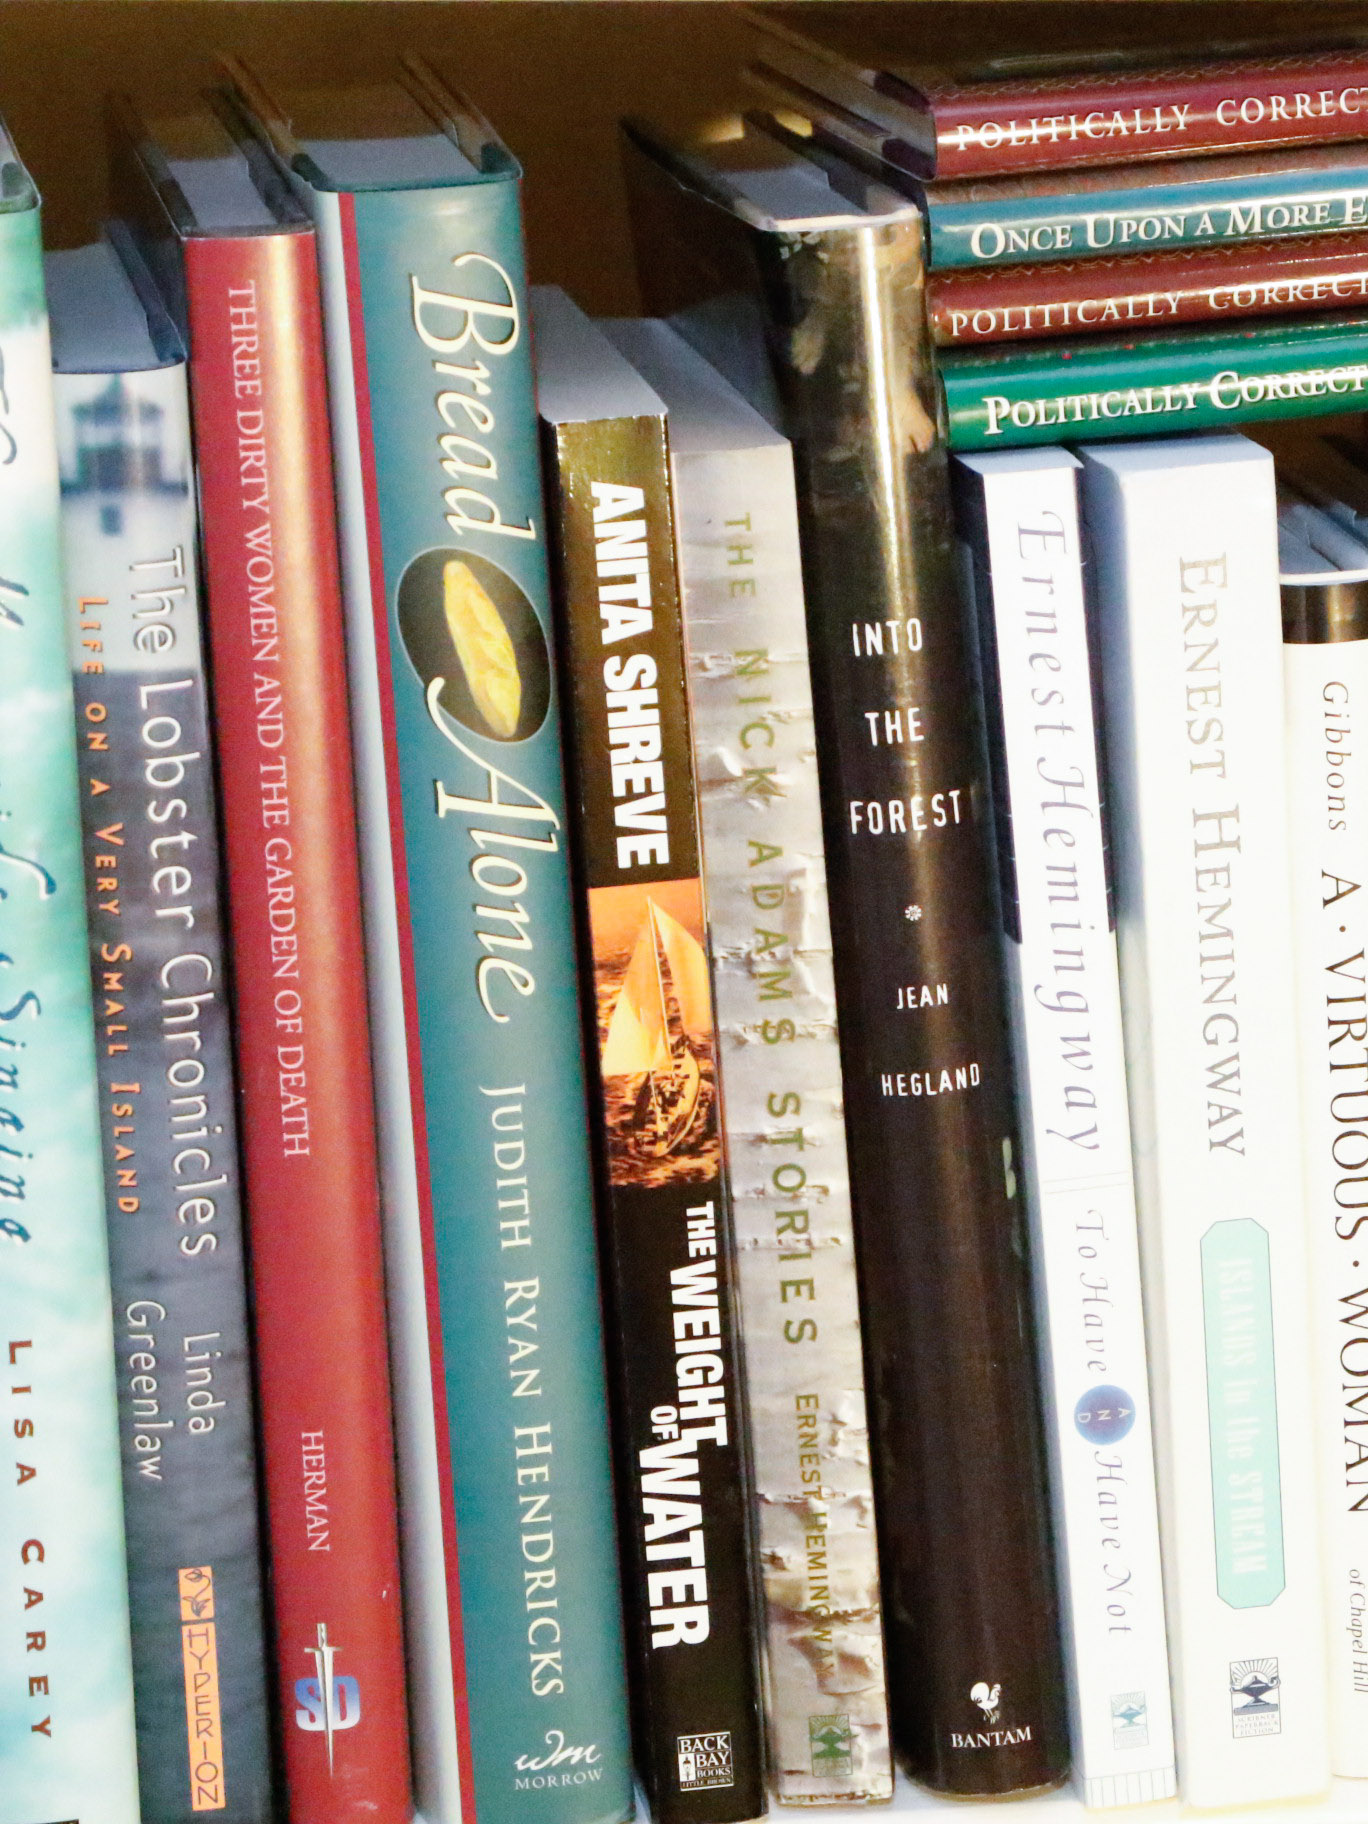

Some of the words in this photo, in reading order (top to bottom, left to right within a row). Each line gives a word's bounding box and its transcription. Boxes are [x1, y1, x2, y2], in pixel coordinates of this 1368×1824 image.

[957, 104, 1190, 152] POLITICALLY
[969, 221, 1071, 260] ONCE
[1085, 212, 1185, 249] UPON
[1195, 214, 1215, 236] A
[1225, 201, 1330, 235] MORE
[229, 280, 262, 399] THREE
[952, 290, 1183, 336] POLITICALLY
[409, 252, 537, 541] Bread
[983, 383, 1201, 435] POLITICALLY
[1209, 365, 1367, 411] CORRECT
[236, 410, 269, 512] DIRTY
[129, 546, 187, 654] The
[244, 522, 279, 662] WOMEN
[590, 480, 654, 645] ANITA
[723, 512, 756, 600] THE
[77, 596, 108, 675] LIFE
[853, 618, 923, 657] INTO
[1017, 510, 1078, 738] Ernest
[1178, 553, 1229, 779] ERNEST
[85, 702, 109, 751] ON
[253, 672, 284, 748] AND
[603, 653, 670, 870] SHREVE
[733, 647, 788, 809] NICK
[865, 707, 925, 746] THE
[1322, 681, 1352, 832] Gibbons
[89, 779, 111, 797] A
[139, 679, 200, 929] Lobster
[259, 755, 290, 829] THE
[850, 790, 961, 835] FOREST
[95, 822, 124, 916] VERY
[427, 676, 562, 1024] Alone
[1322, 869, 1362, 910] A
[264, 837, 299, 979] GARDEN
[747, 841, 796, 1045] ADAMS
[1034, 755, 1099, 1152] Hemingway
[102, 943, 132, 1056] SMALL
[274, 989, 304, 1034] OF
[897, 983, 949, 1010] JEAN
[1191, 805, 1246, 1157] HEMINGWAY
[161, 953, 228, 1257] Chronicles
[276, 1045, 310, 1158] DEATH
[882, 1063, 981, 1097] HEGLAND
[109, 1081, 141, 1214] ISLAND
[479, 1083, 532, 1249] JUDITH
[686, 1200, 717, 1259] THE
[766, 1092, 818, 1346] STORIES
[1077, 1209, 1105, 1260] To
[503, 1276, 542, 1398] RYAN
[670, 1259, 728, 1446] WEIGHT
[1079, 1272, 1117, 1373] Have
[8, 1340, 36, 1485] LISA
[126, 1300, 173, 1481] Greenlaw
[183, 1332, 226, 1435] Linda
[650, 1405, 678, 1441] OF
[301, 1430, 330, 1552] HERMAN
[796, 1393, 823, 1500] ERNEST
[1095, 1450, 1121, 1548] Have
[513, 1423, 564, 1698] HENDRICKS
[639, 1440, 710, 1649] WATER
[806, 1510, 836, 1681] HEMINGWAY
[1349, 1569, 1361, 1589] of
[20, 1539, 52, 1737] CAREY
[1103, 1561, 1134, 1635] Not
[1349, 1594, 1368, 1652] Chapel
[186, 1628, 219, 1806] HYPERION
[680, 1735, 729, 1753] BACK
[696, 1751, 729, 1768] BAY
[951, 1726, 1031, 1749] BANTAM
[514, 1767, 603, 1790] MORROW
[697, 1767, 731, 1778] BOOKS
